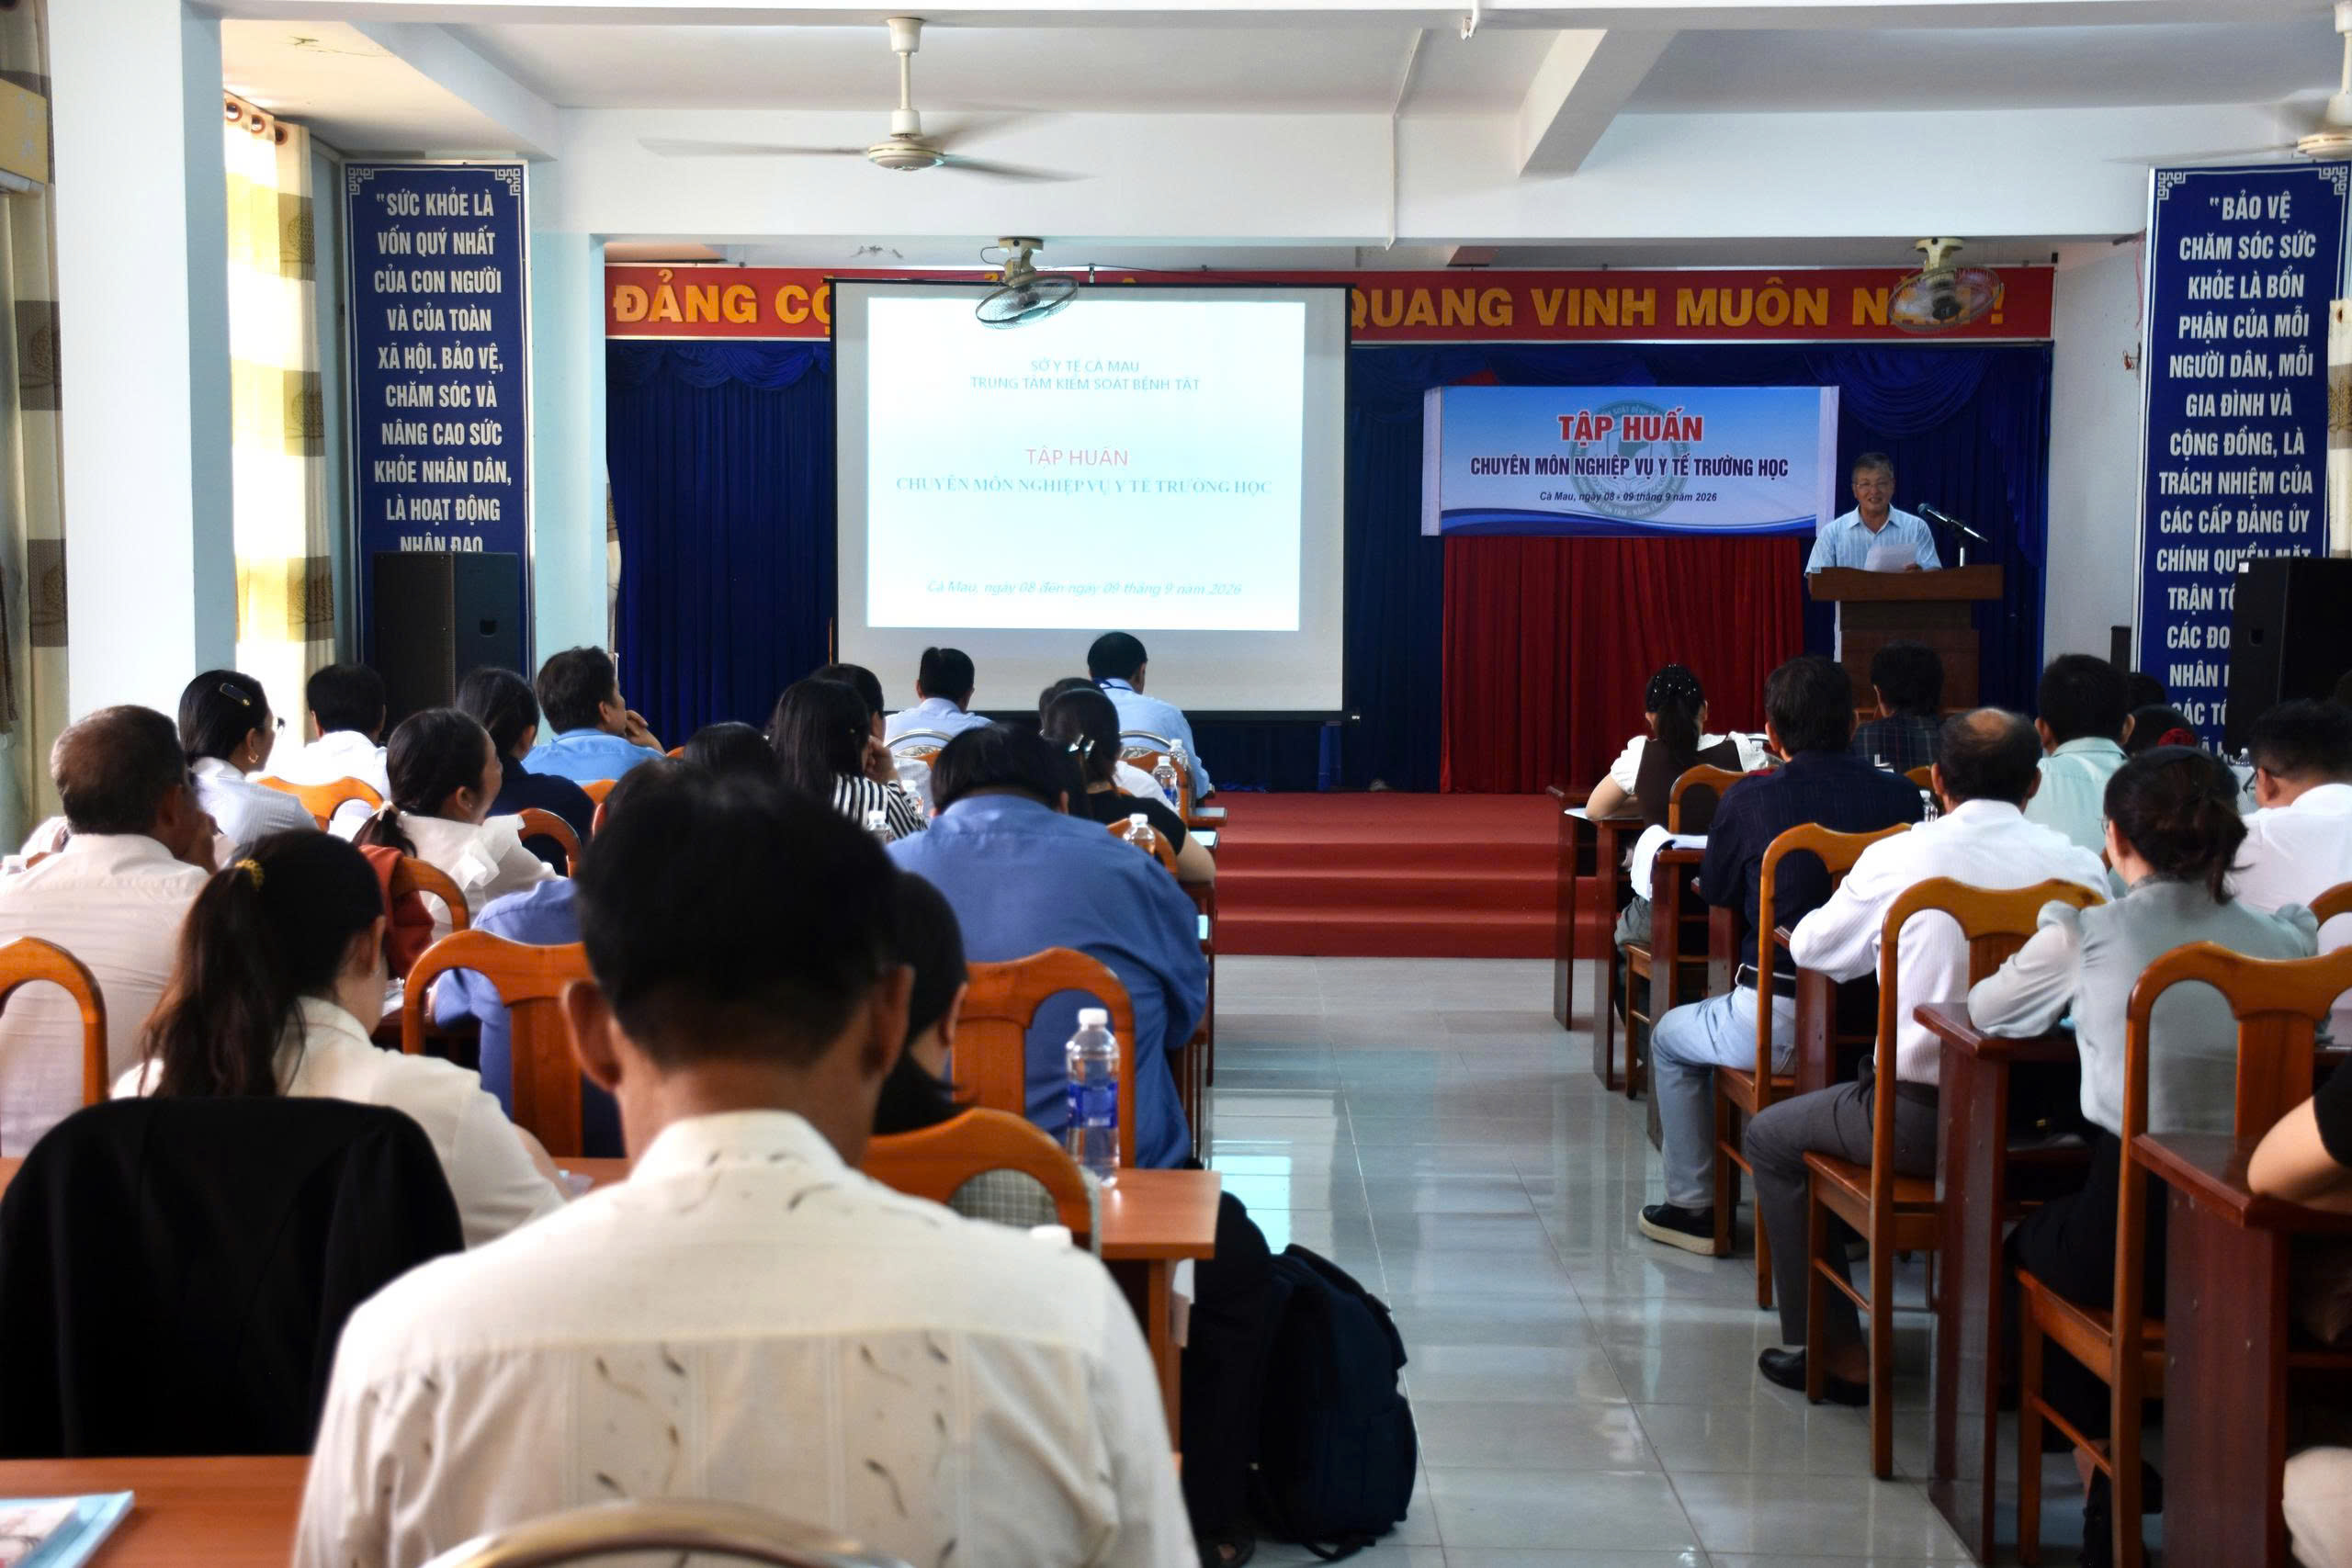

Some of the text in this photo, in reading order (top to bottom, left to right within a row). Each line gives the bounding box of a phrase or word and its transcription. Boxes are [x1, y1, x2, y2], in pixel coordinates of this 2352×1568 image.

[426, 187, 469, 216] KHỎE
[474, 189, 493, 216] LÀ
[2267, 191, 2290, 223] VỆ
[378, 225, 495, 256] VỐN QUÝ NHẤT
[2180, 230, 2315, 260] CHĂM SÓC SỨC
[375, 265, 501, 293] CỦA CON NGƯỜI
[2188, 265, 2304, 299] KHỎE LÀ BỔN
[613, 269, 758, 324] ĐẢNG
[1535, 288, 1655, 326] VINH
[1676, 277, 1829, 327] MUÔN
[387, 302, 492, 331] VÀ CỦA TOÀN
[2179, 306, 2309, 344] PHẬN CỦA MỖI
[379, 340, 503, 374] XÃ HỘI. BẢO VỆ,
[1053, 361, 1062, 372] Y
[1108, 361, 1140, 372] MAU
[2170, 345, 2312, 379] NGƯỜI DÂN, MỖI
[386, 380, 497, 407] CHĂM SÓC VÀ
[970, 377, 1020, 390] TRUNG
[2186, 389, 2291, 417] GIA ĐÌNH VÀ
[382, 419, 502, 446] NÂNG CAO SỨC
[1558, 407, 1702, 446] TẬP HUẤN
[2170, 426, 2304, 460] CỘNG ĐỒNG, LÀ
[375, 455, 511, 485] KHỎE NHÂN DÂN,
[1470, 453, 1789, 480] CHUYÊN MÔN NGHIỆP VỤ Y TẾ TRƯỜNG HỌC
[1115, 479, 1126, 493] Y
[2159, 465, 2312, 499] TRÁCH NHIỆM CỦA
[387, 494, 500, 525] LÀ HOẠT ĐỘNG
[1540, 491, 1552, 501] Cà
[1555, 491, 1577, 502] Mau,
[1579, 492, 1601, 502] ngày
[1603, 491, 1614, 501] 08
[1623, 492, 1634, 501] 09
[1636, 492, 1663, 503] tháng
[1665, 492, 1671, 502] 9
[1673, 492, 1693, 502] năm
[1696, 492, 1717, 502] 2026
[2161, 503, 2310, 533] CÁC CẤP ĐẢNG ỦY
[401, 532, 446, 551] NHÂN
[2157, 545, 2208, 571] CHÍNH
[2168, 583, 2212, 615] TRẬN
[2167, 622, 2230, 649] CÁC ĐO
[2170, 660, 2218, 686] NHÂN
